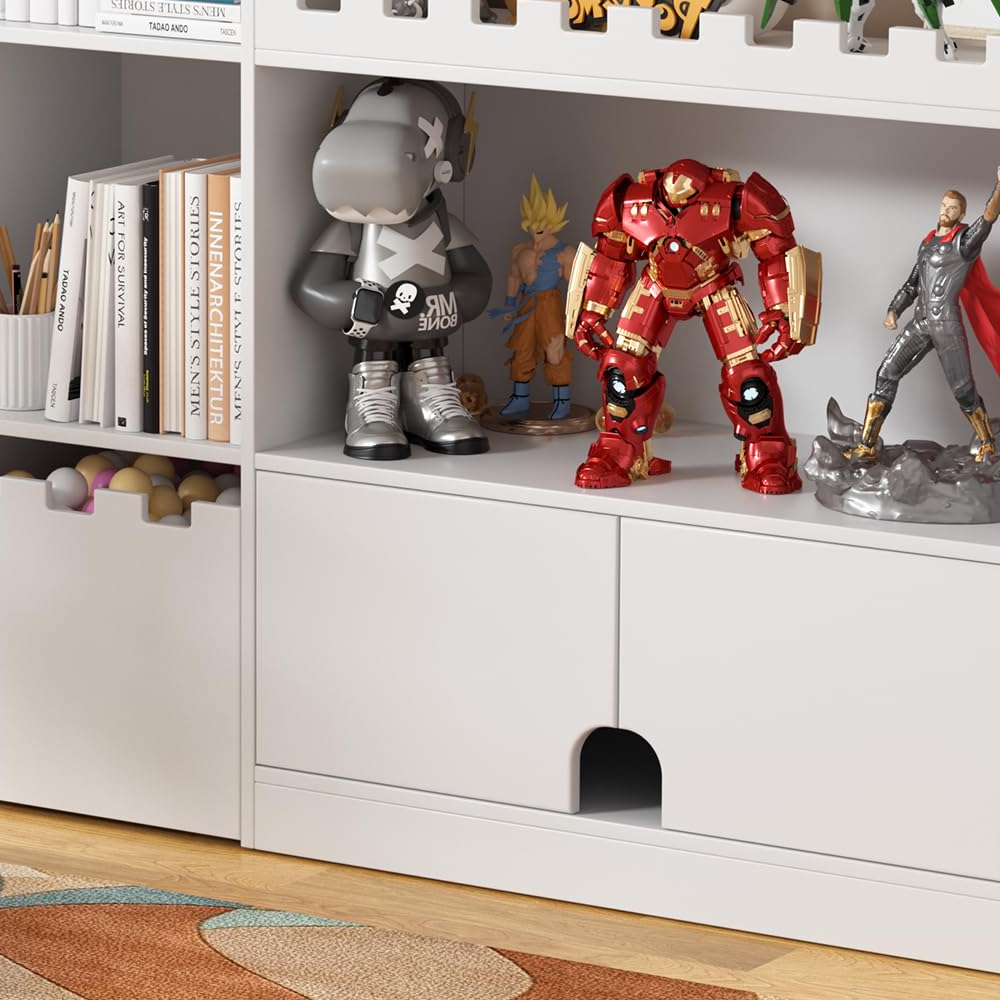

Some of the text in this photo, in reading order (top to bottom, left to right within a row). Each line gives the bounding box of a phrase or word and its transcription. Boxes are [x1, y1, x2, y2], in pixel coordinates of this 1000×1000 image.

[111, 0, 226, 18] MEN'S STYLE STORIES
[149, 22, 188, 33] TADAO ANDO
[57, 269, 69, 332] TADAO ANDO
[117, 200, 125, 328] ART FOR SURVIVAL
[189, 195, 200, 417] MEN'S STYLE STORIES
[209, 211, 224, 425] INNENARCHITEKTUR
